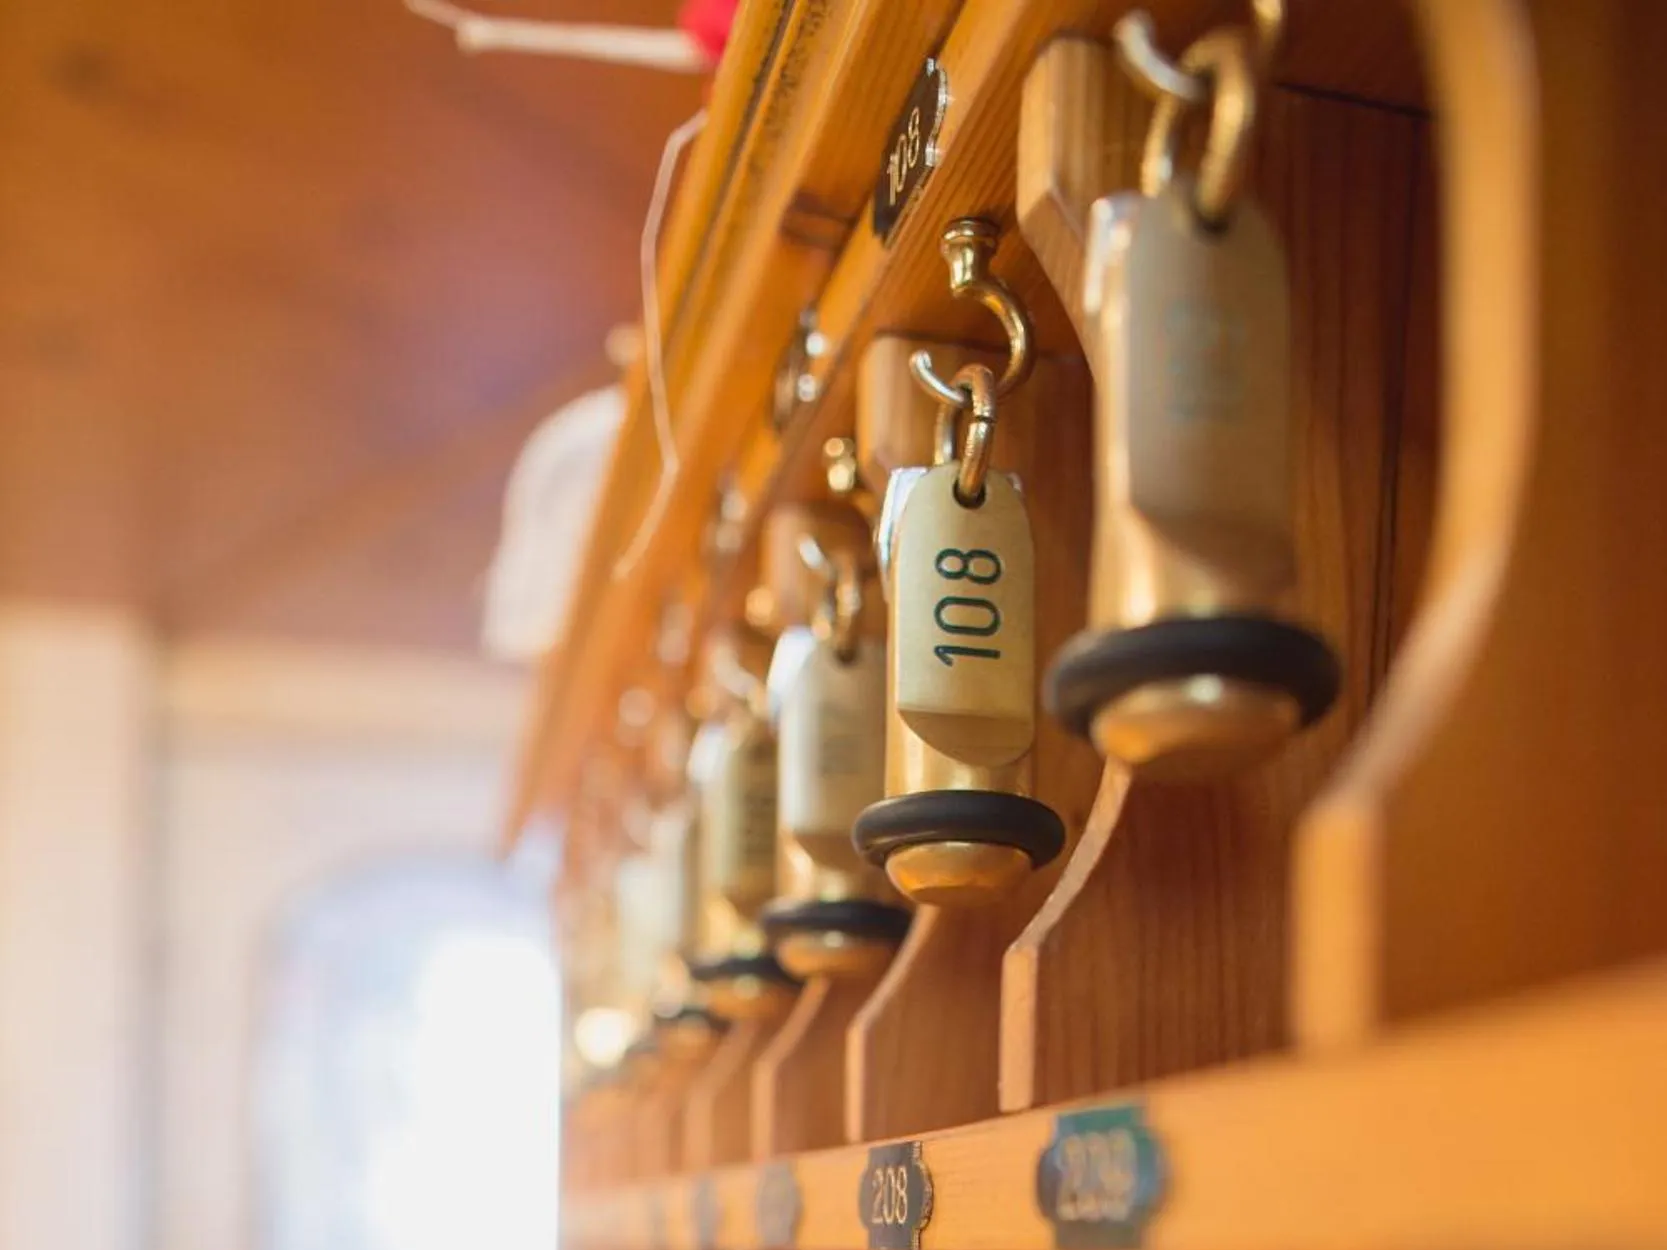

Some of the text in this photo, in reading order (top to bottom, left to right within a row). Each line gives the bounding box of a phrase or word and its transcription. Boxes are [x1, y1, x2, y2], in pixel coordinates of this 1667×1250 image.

[887, 106, 920, 206] 108
[934, 548, 1002, 667] 108
[871, 1165, 908, 1225] 208
